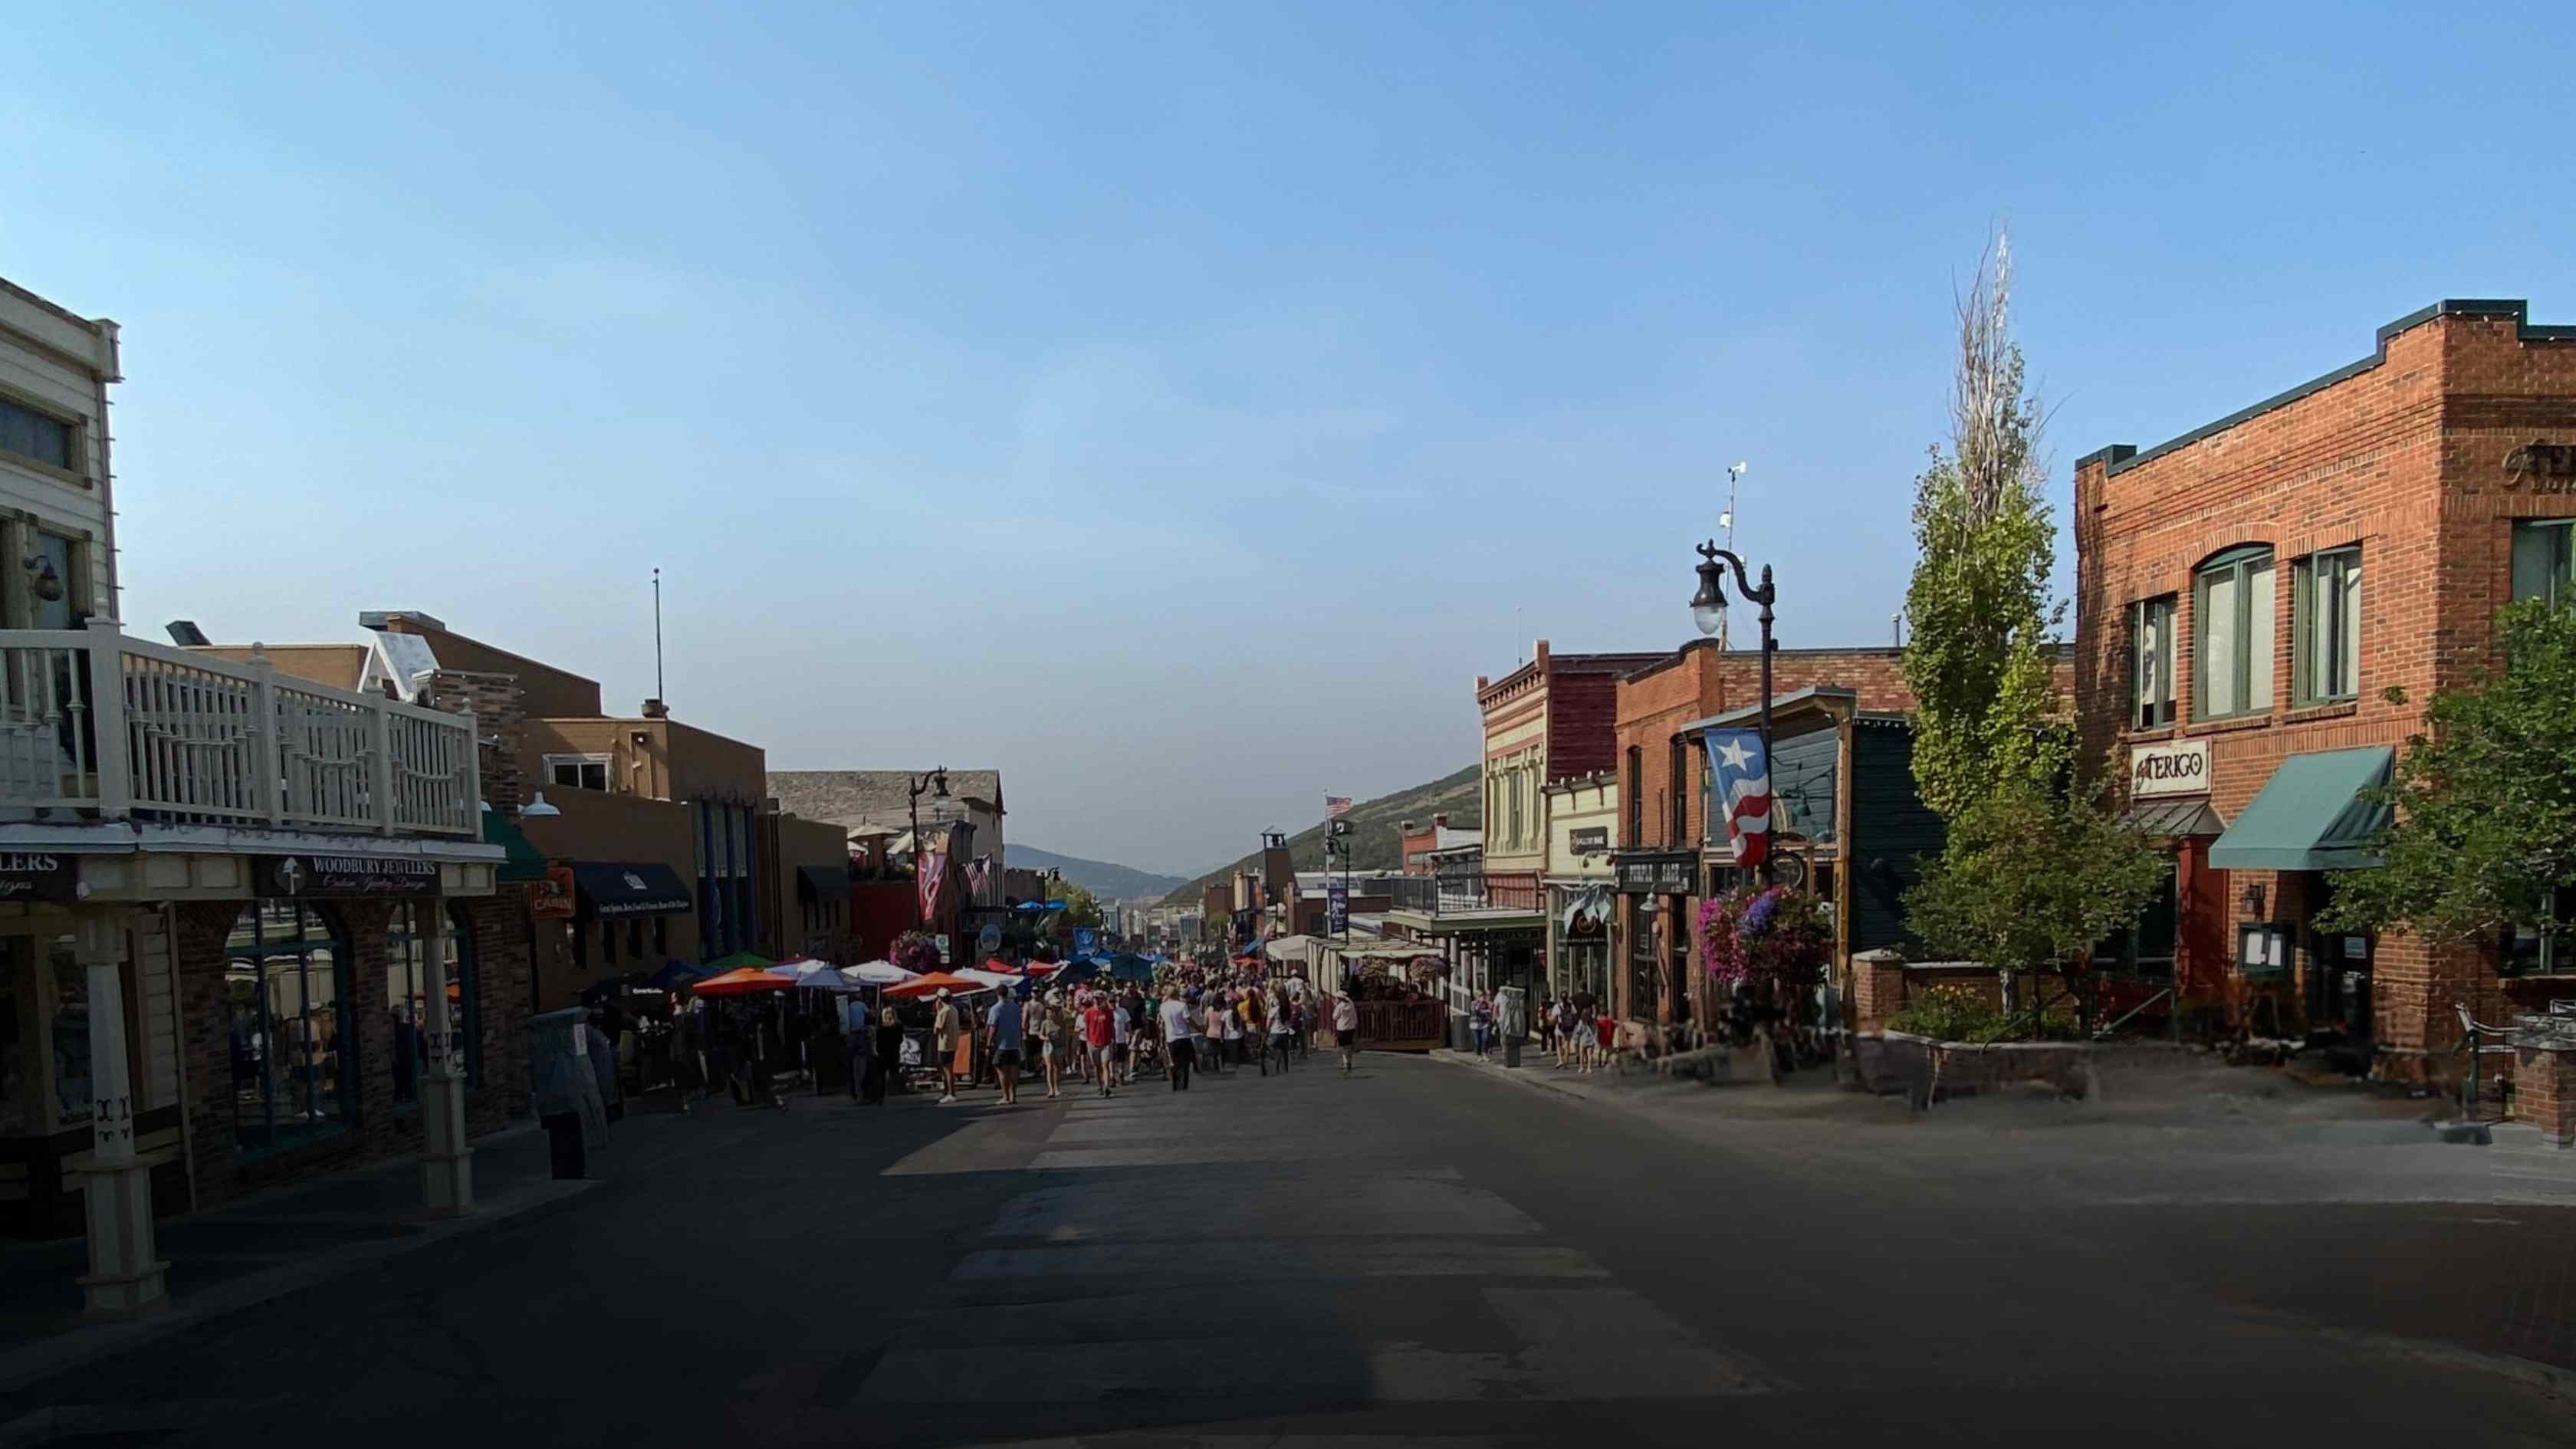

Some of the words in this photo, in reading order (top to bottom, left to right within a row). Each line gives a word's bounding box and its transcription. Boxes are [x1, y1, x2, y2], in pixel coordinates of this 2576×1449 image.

[2146, 753, 2202, 780] TERIGO
[313, 856, 380, 874] WOODBURY
[533, 897, 572, 911] CABIN
